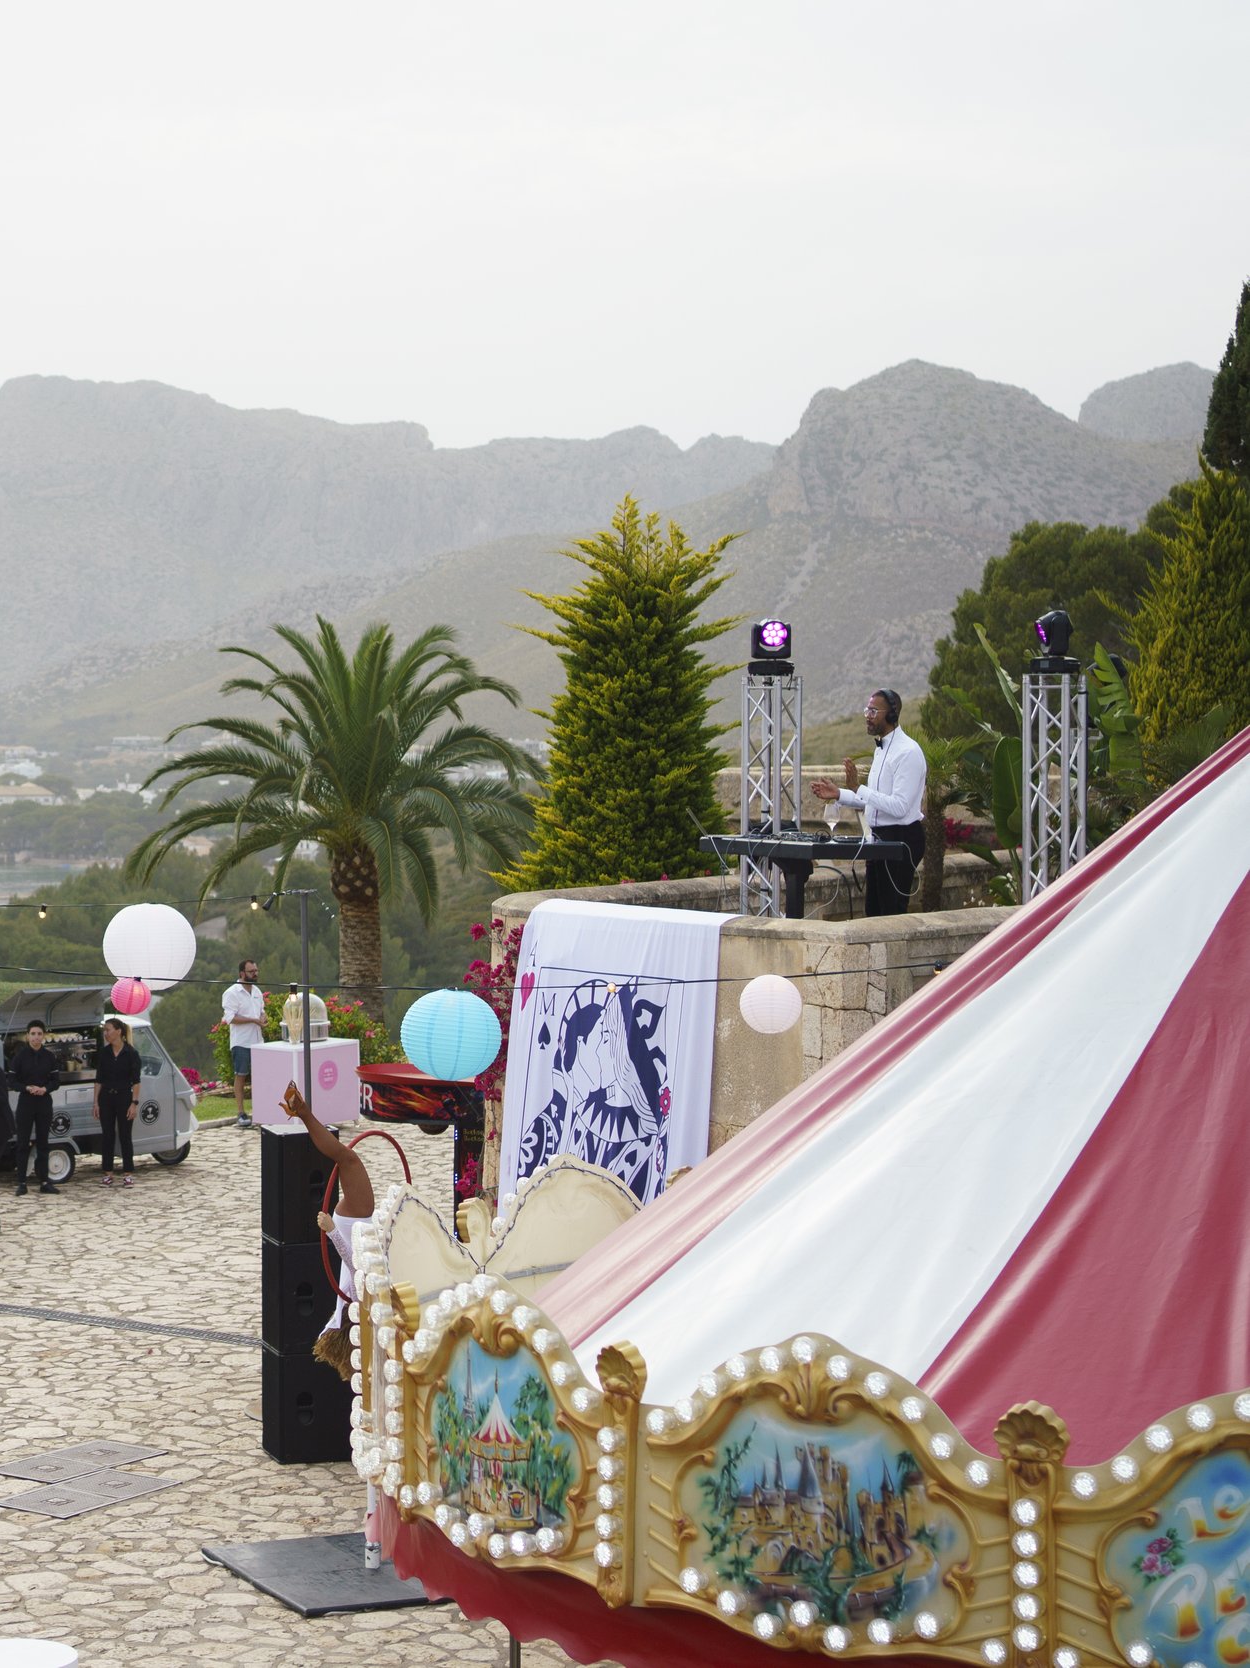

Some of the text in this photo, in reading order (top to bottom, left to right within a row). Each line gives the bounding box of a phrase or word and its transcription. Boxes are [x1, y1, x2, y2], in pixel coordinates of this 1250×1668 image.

[527, 940, 538, 967] A
[539, 991, 557, 1017] M
[359, 1081, 374, 1111] R
